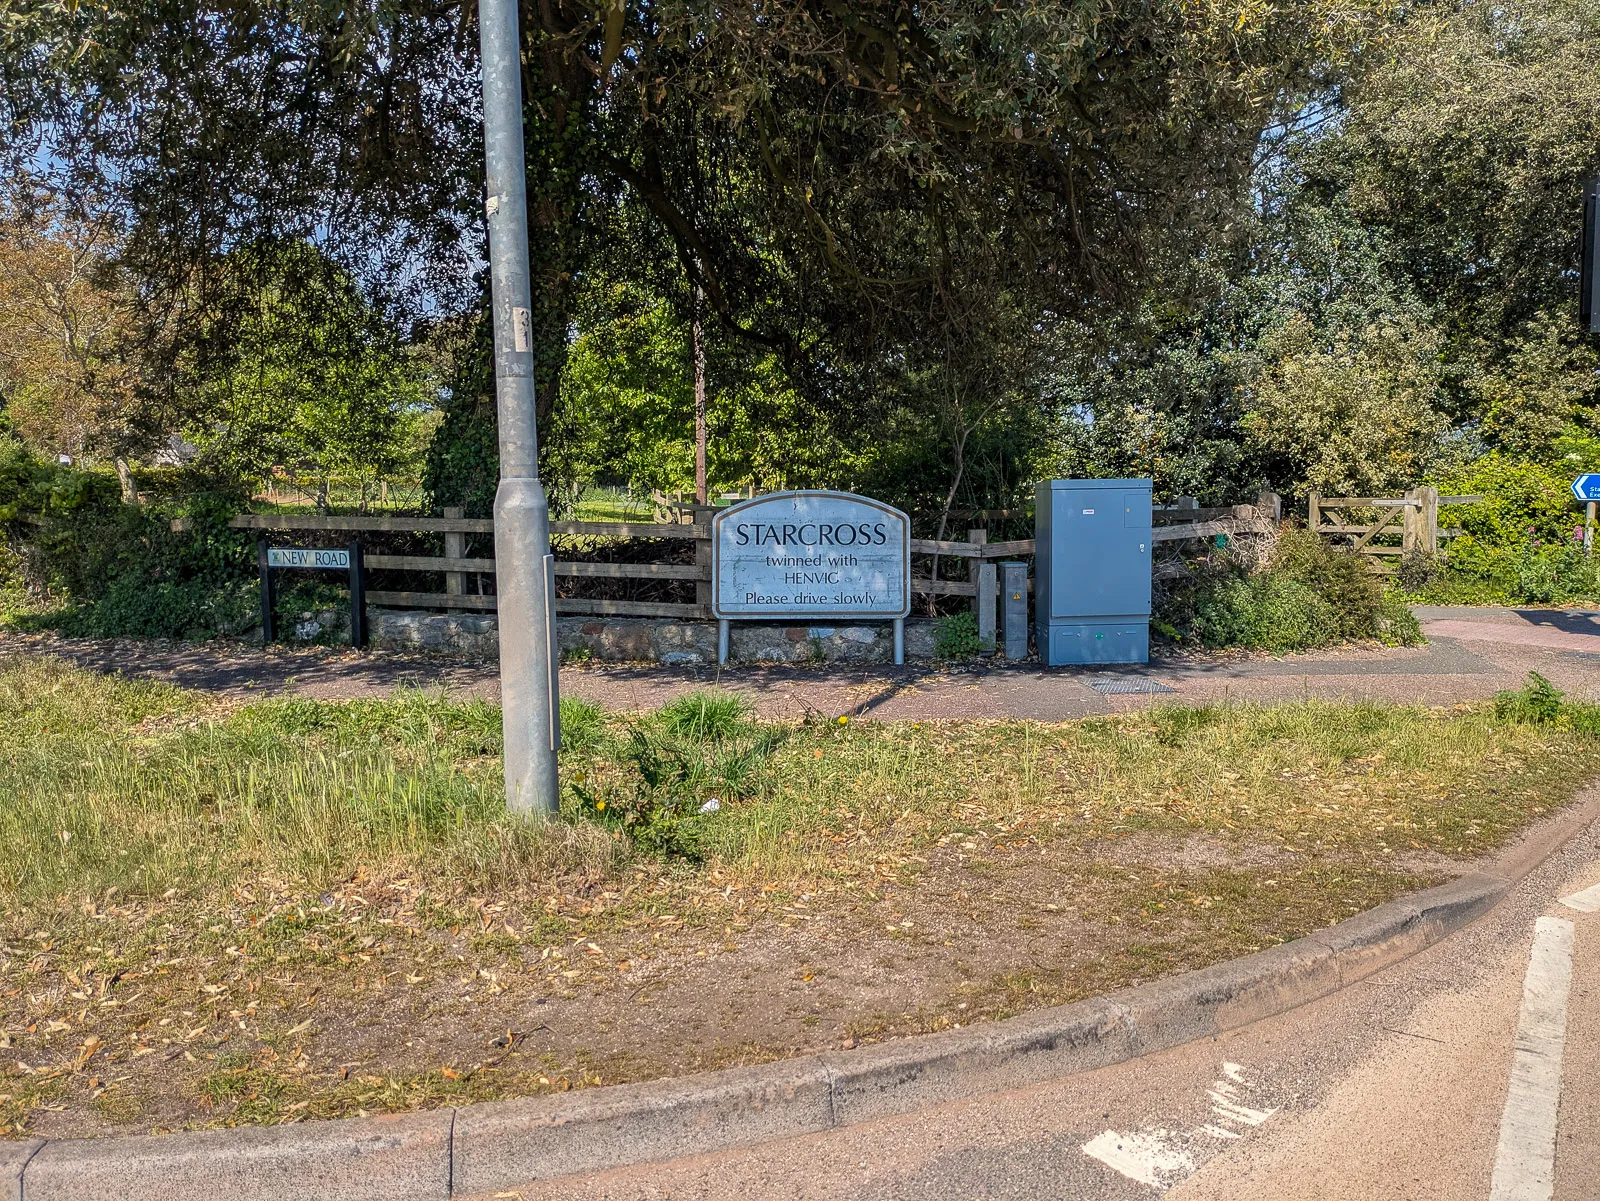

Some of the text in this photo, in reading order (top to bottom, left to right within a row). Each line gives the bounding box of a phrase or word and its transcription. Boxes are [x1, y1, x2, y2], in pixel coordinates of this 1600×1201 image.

[736, 523, 887, 546] STARCROSS
[282, 551, 348, 566] NEW ROAD
[766, 554, 858, 567] twinned with
[784, 572, 840, 585] HENVIC
[745, 592, 877, 608] Please drive slowly
